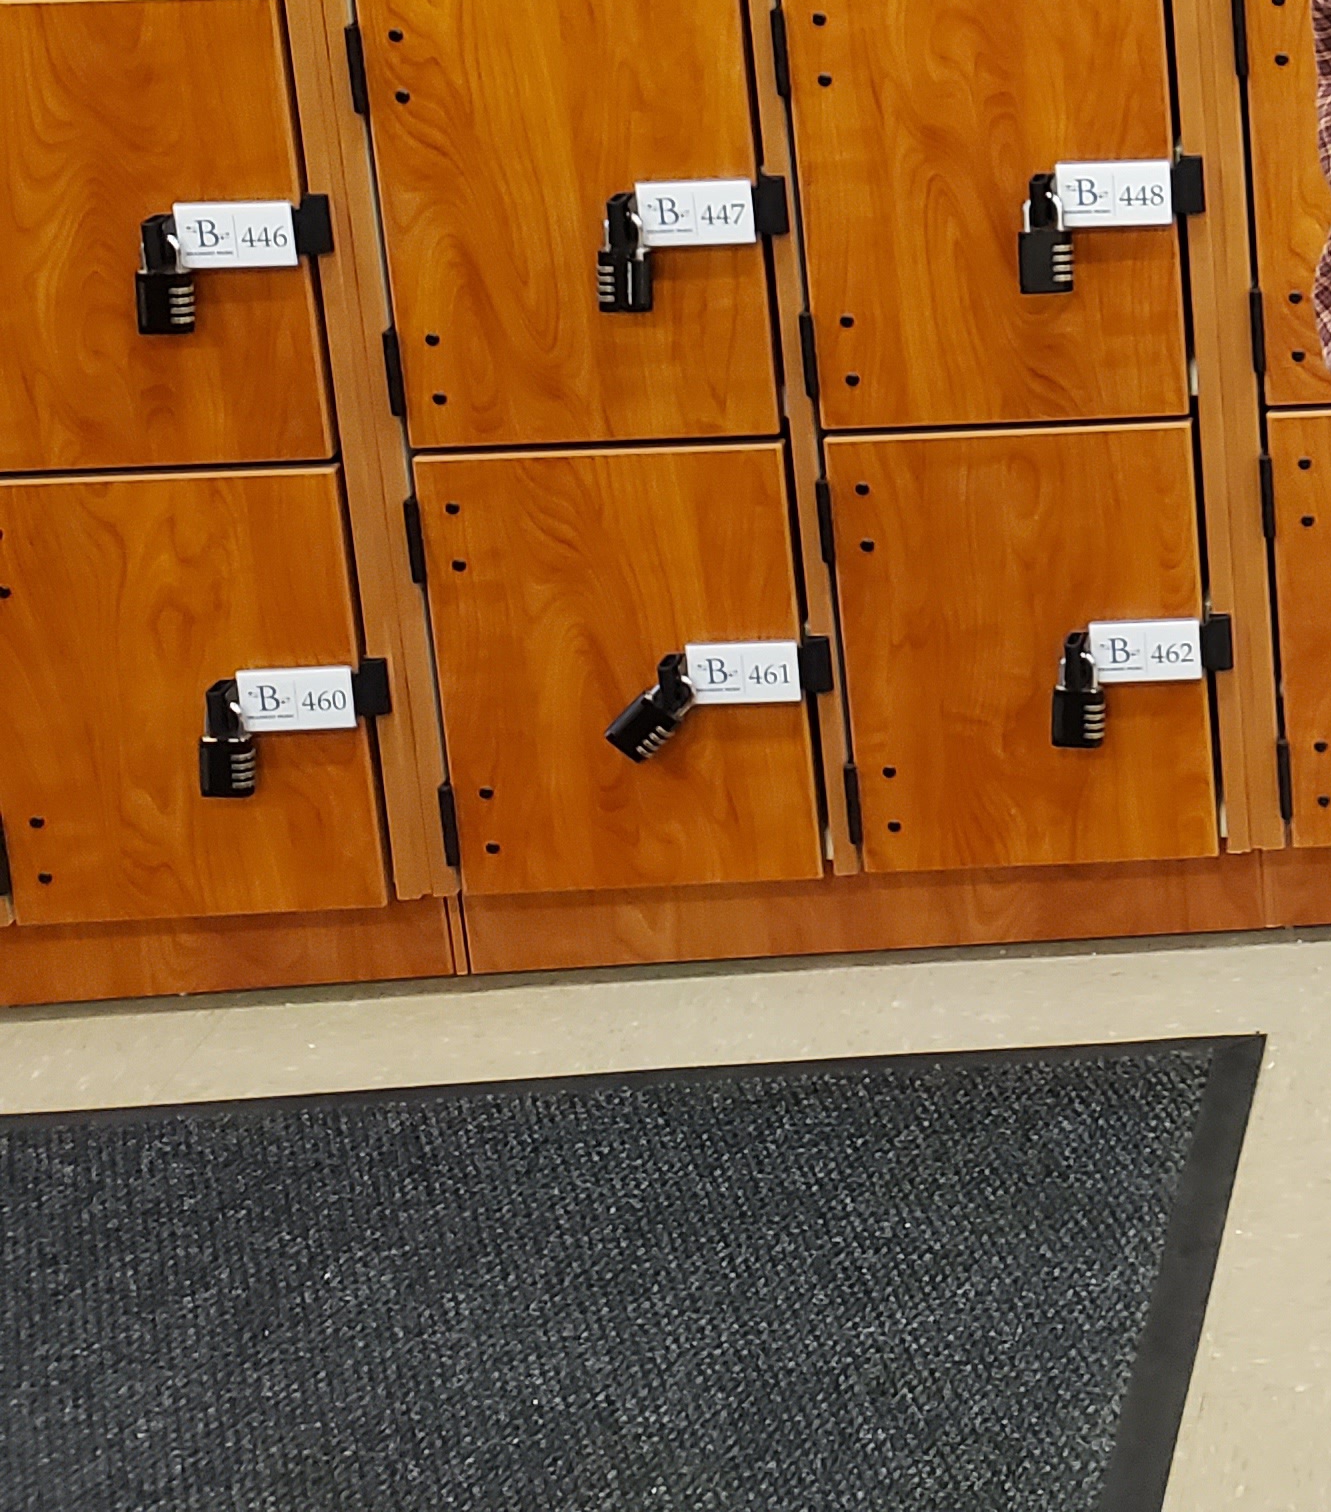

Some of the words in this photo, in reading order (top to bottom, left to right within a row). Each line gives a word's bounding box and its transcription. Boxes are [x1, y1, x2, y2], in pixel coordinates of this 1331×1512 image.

[1075, 179, 1100, 206] B
[1119, 185, 1164, 206] 448
[656, 198, 679, 225] B
[701, 204, 745, 225] 447
[195, 220, 219, 247] B
[241, 226, 287, 247] 446
[1108, 638, 1132, 664] B
[1151, 643, 1194, 663] 462
[706, 658, 730, 684] B
[749, 664, 789, 684] 461
[256, 685, 280, 711] B
[302, 690, 346, 711] 460
